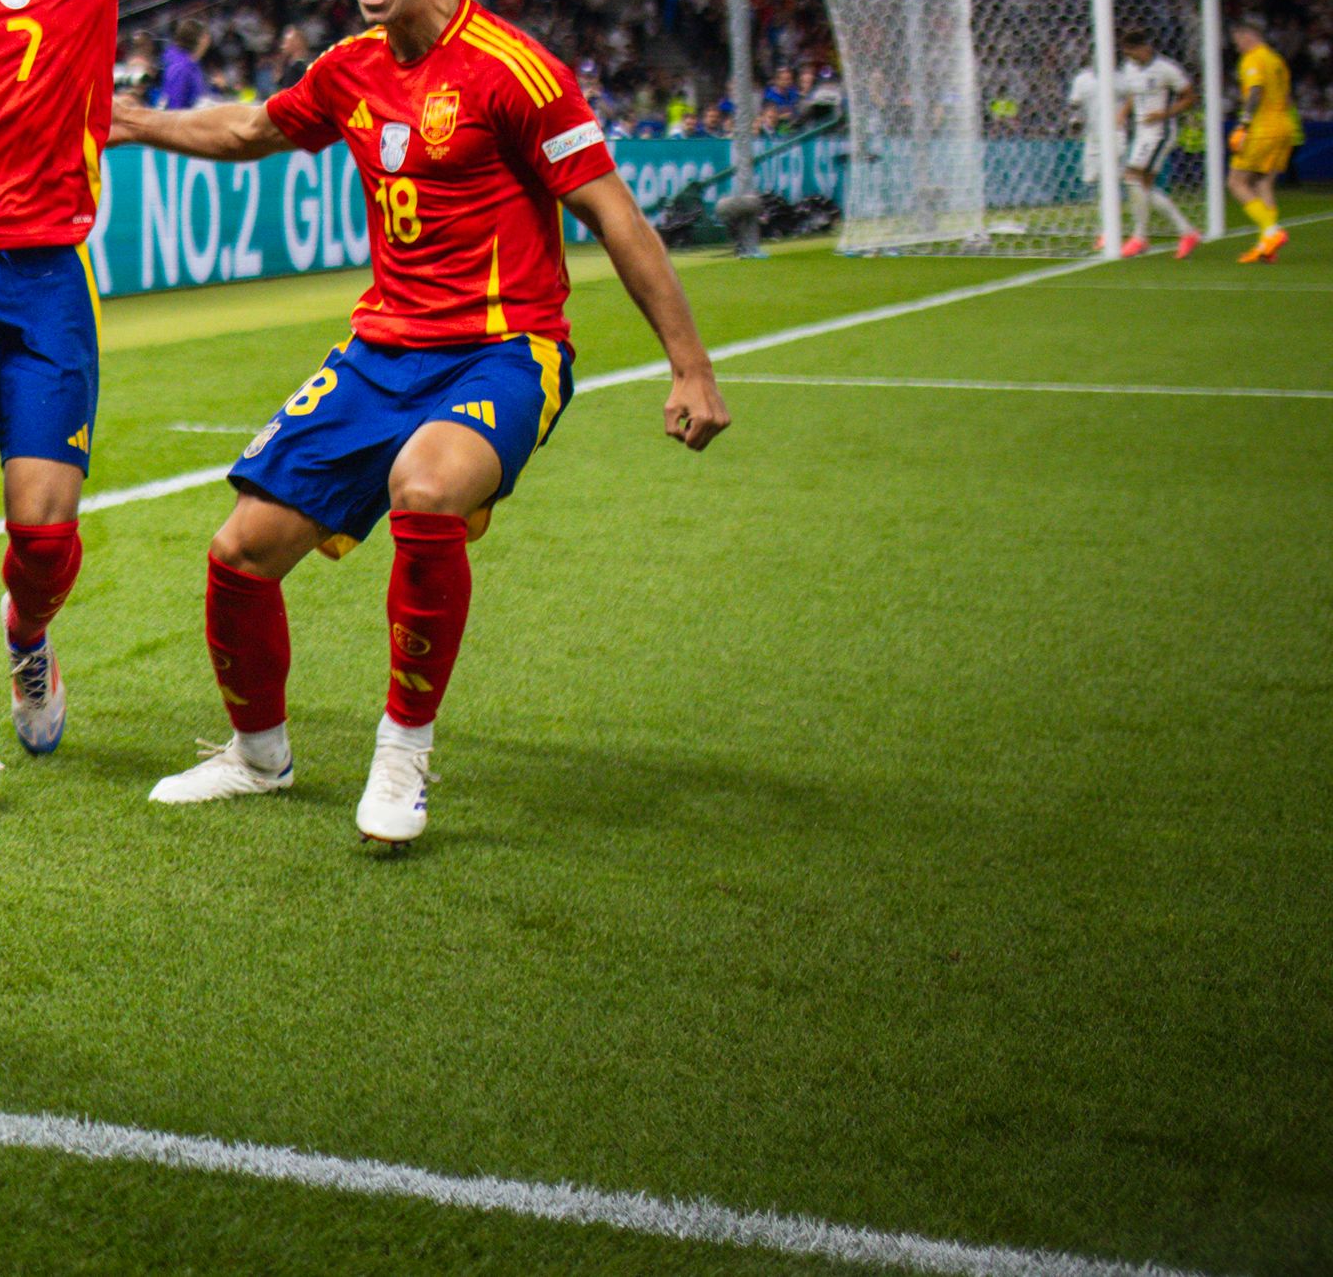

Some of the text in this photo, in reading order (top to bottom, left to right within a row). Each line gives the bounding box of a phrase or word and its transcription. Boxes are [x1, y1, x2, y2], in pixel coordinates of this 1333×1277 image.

[7, 17, 43, 82] 7
[140, 144, 263, 290] NO.2
[284, 145, 371, 271] GLO
[375, 176, 422, 244] 18
[285, 366, 338, 417] 8
